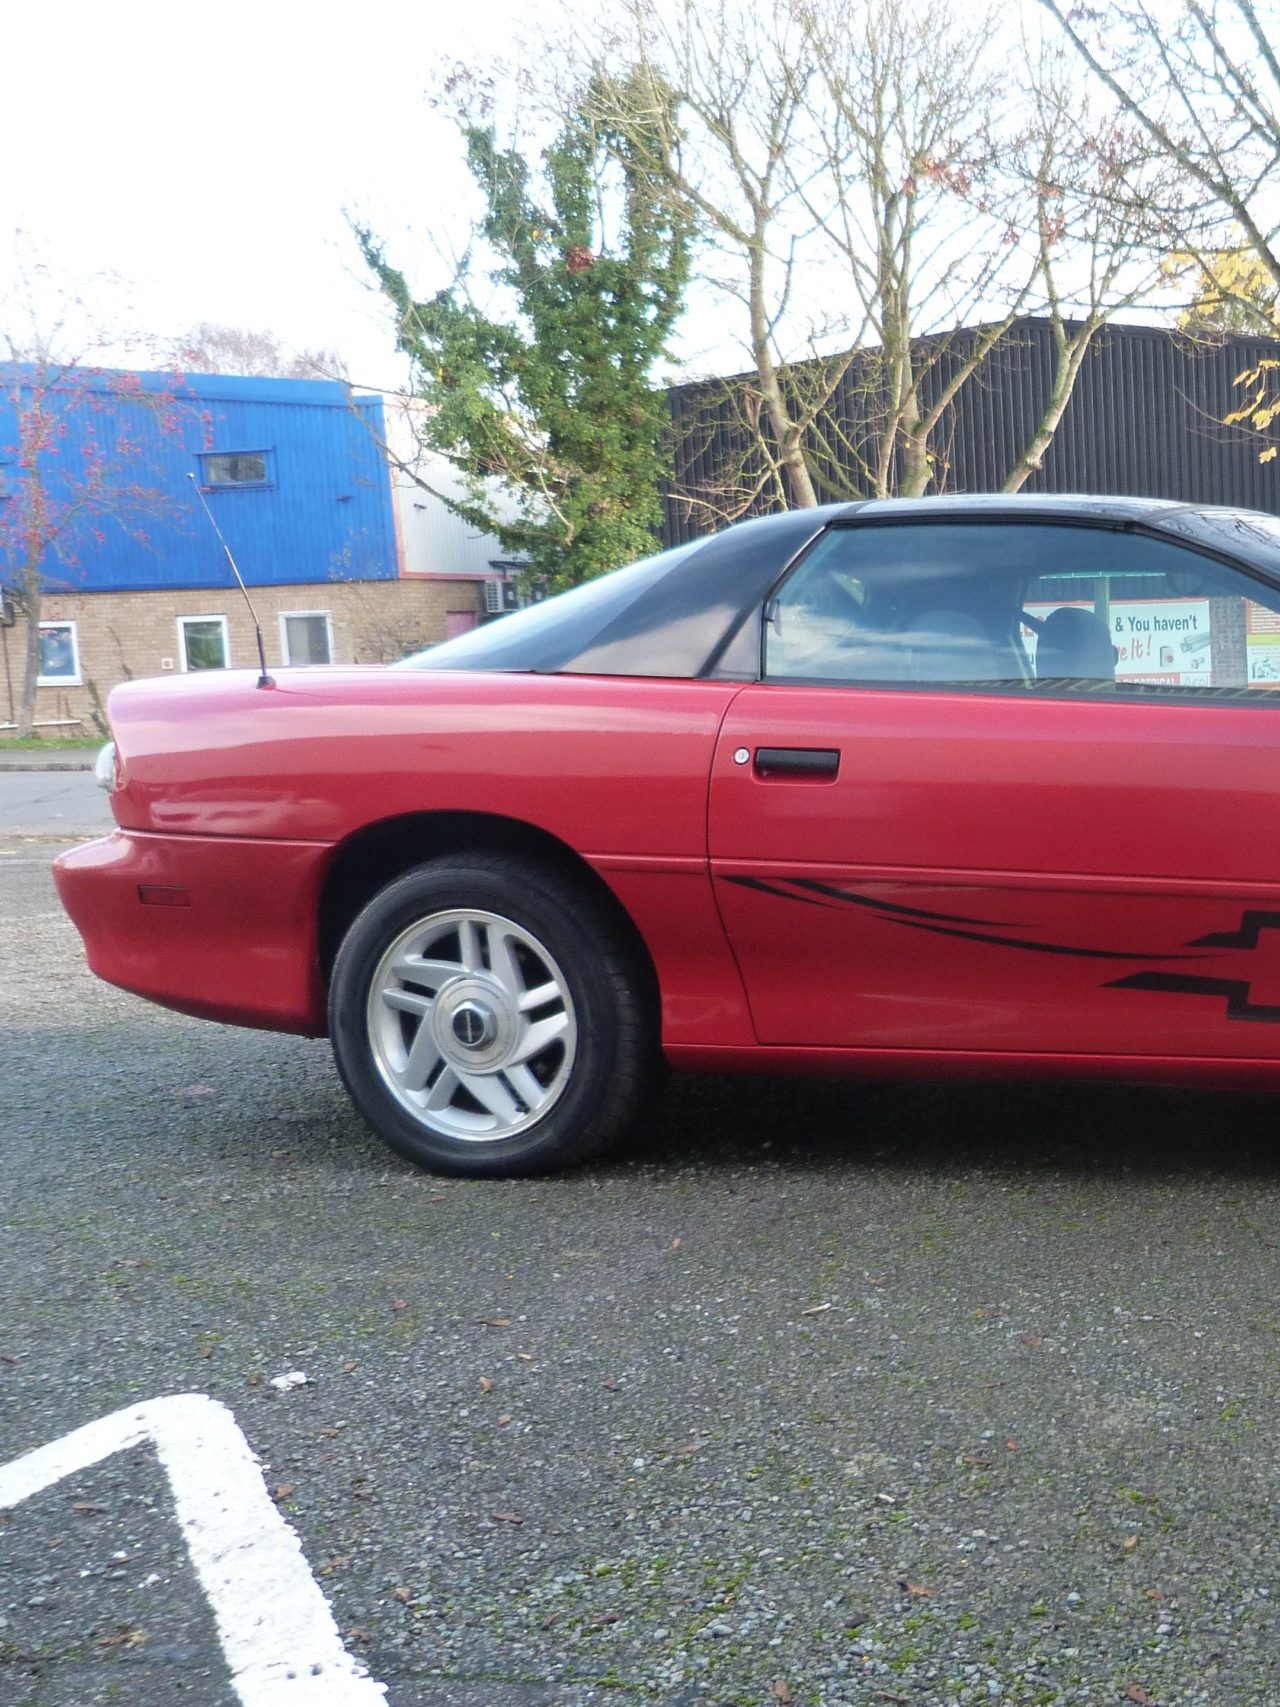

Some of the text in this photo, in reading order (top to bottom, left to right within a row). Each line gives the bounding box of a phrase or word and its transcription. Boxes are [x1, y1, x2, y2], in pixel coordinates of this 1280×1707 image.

[1115, 614, 1198, 632] & You haven't
